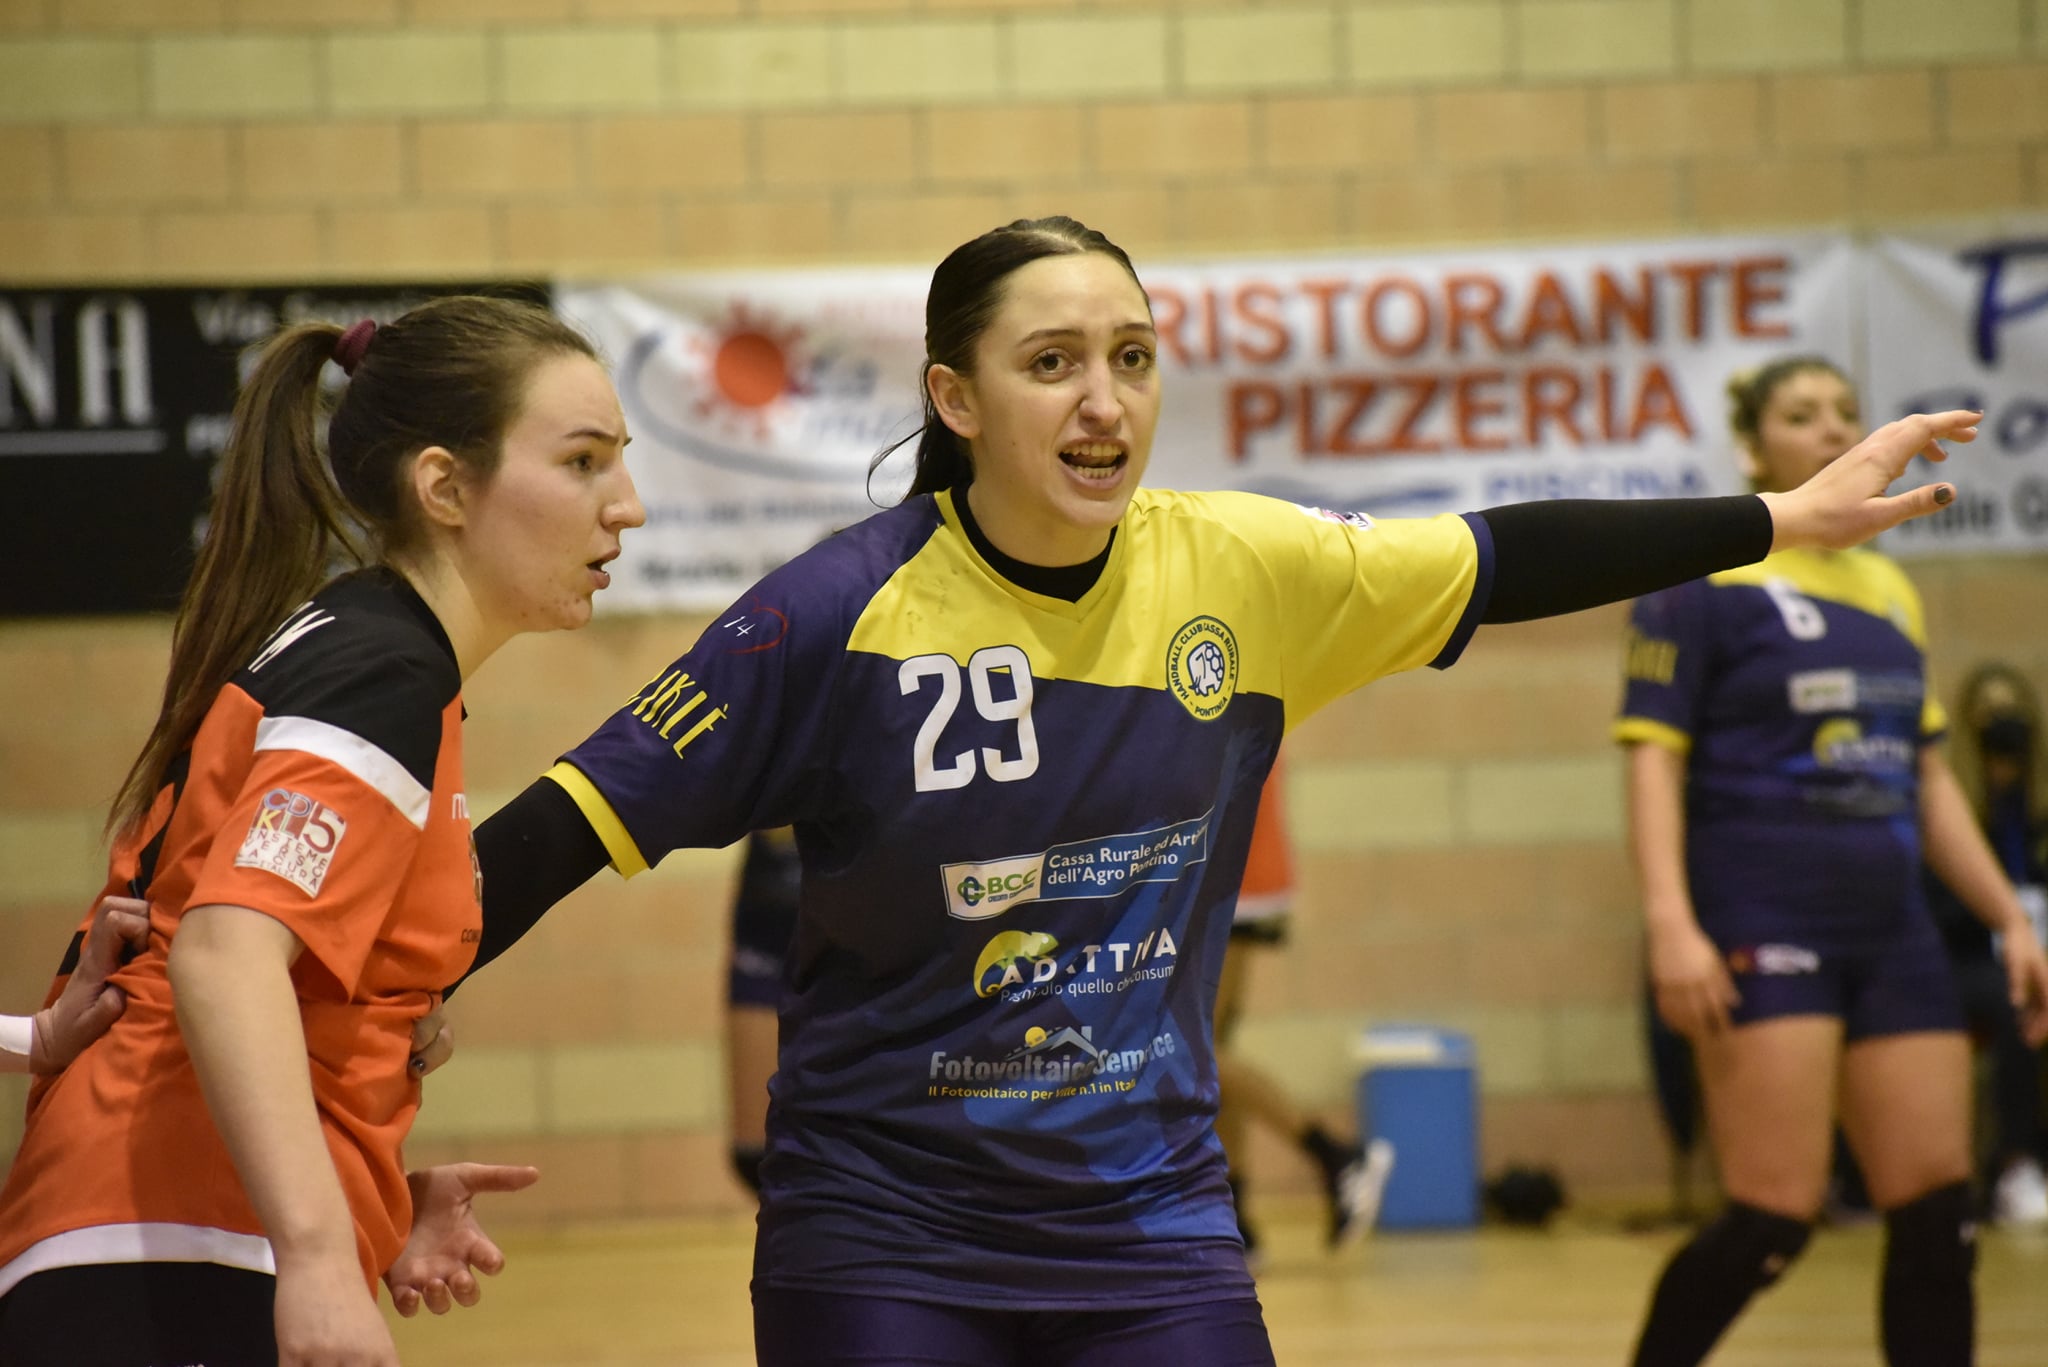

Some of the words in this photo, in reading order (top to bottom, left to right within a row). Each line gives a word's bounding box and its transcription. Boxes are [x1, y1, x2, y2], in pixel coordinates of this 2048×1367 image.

[1144, 256, 1791, 368] RISTORANTE
[1224, 361, 1695, 463] PIZZERIA
[1180, 623, 1203, 645] CLUB
[1223, 637, 1235, 680] RURALE
[1171, 645, 1190, 700] HANDBALL
[898, 644, 1040, 793] 29
[1048, 853, 1095, 869] Cassa
[1099, 843, 1152, 863] Rurale
[987, 867, 1037, 894] BCC
[1047, 868, 1125, 886] dell'Agro
[1068, 977, 1115, 998] quello
[928, 1086, 938, 1097] Il
[941, 1086, 1029, 1099] Fotovoltaico
[1031, 1089, 1054, 1102] per
[1079, 1083, 1097, 1096] n.1
[1099, 1081, 1112, 1093] in
